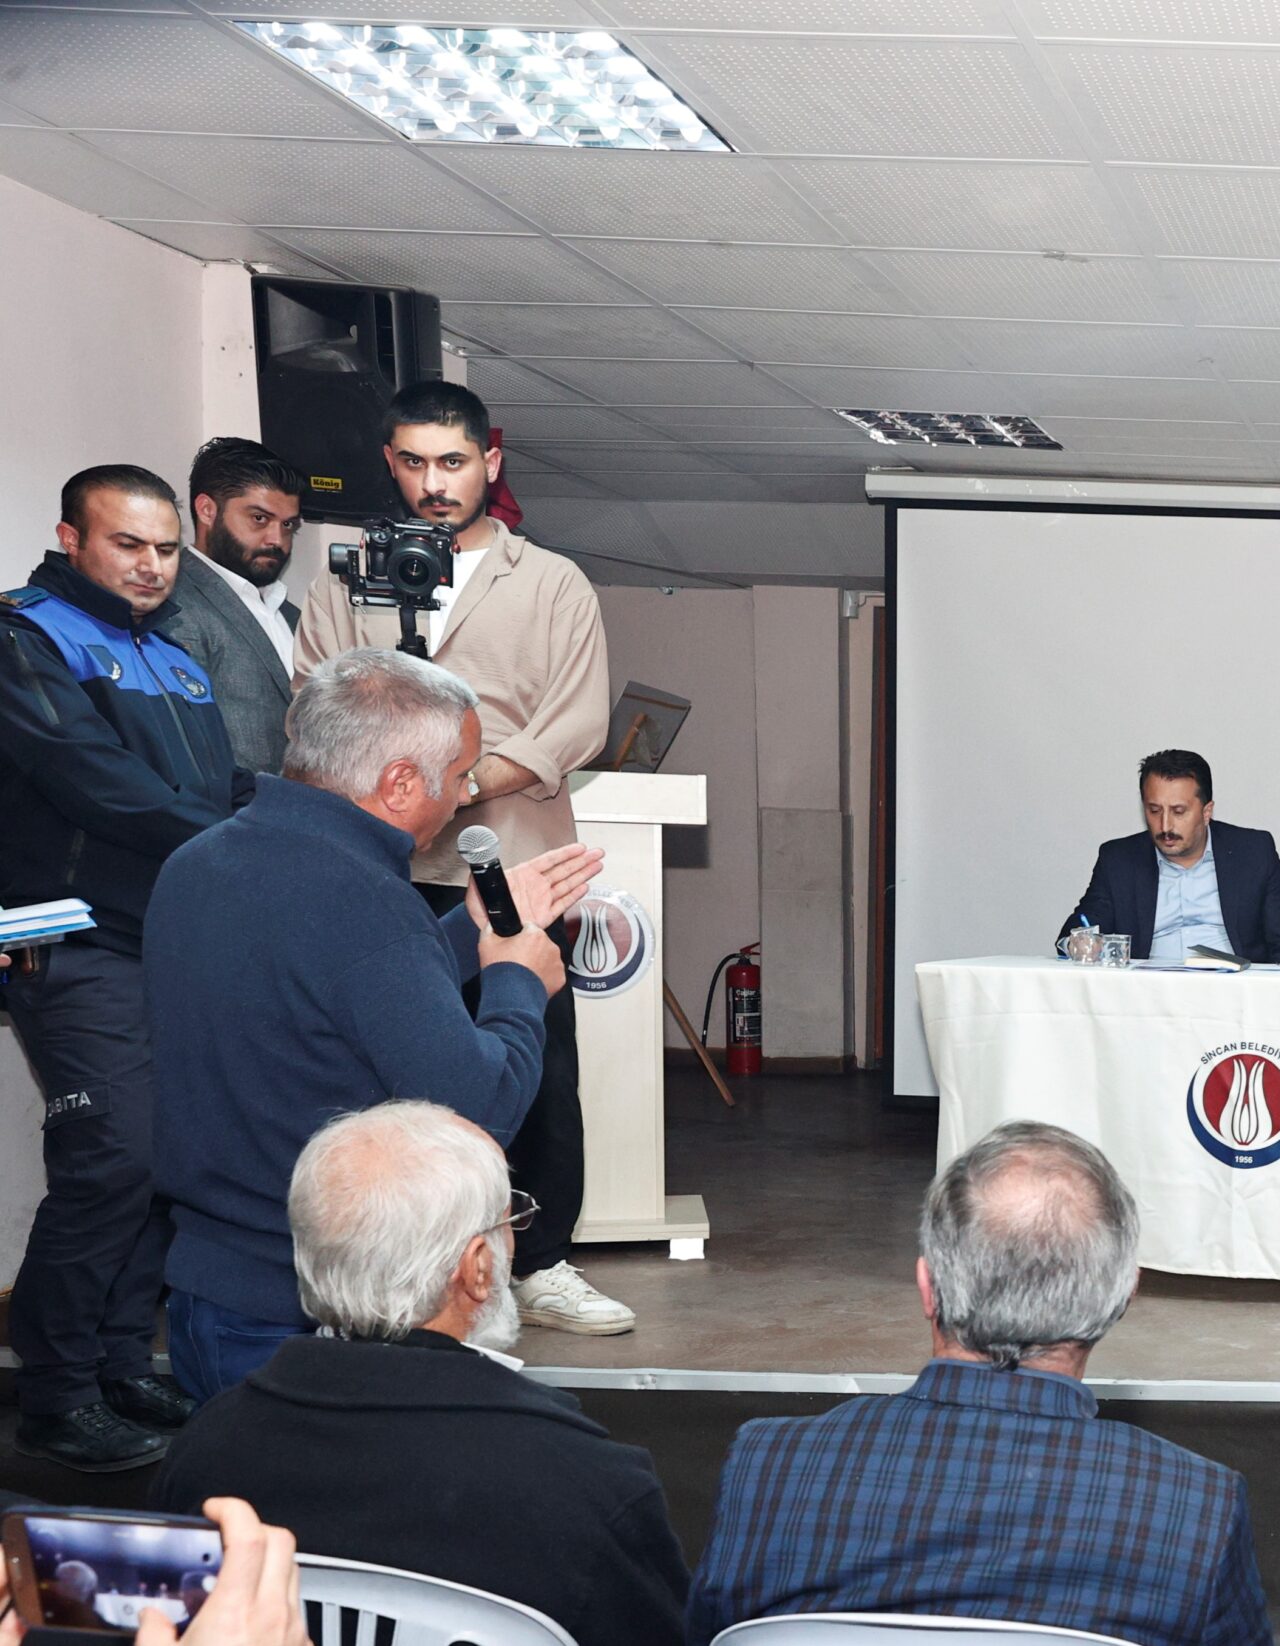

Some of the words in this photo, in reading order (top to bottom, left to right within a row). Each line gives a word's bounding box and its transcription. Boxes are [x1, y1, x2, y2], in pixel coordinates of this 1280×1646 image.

[313, 478, 340, 489] König
[1201, 1043, 1237, 1065] SİNCAN
[1235, 1155, 1253, 1164] 1956
